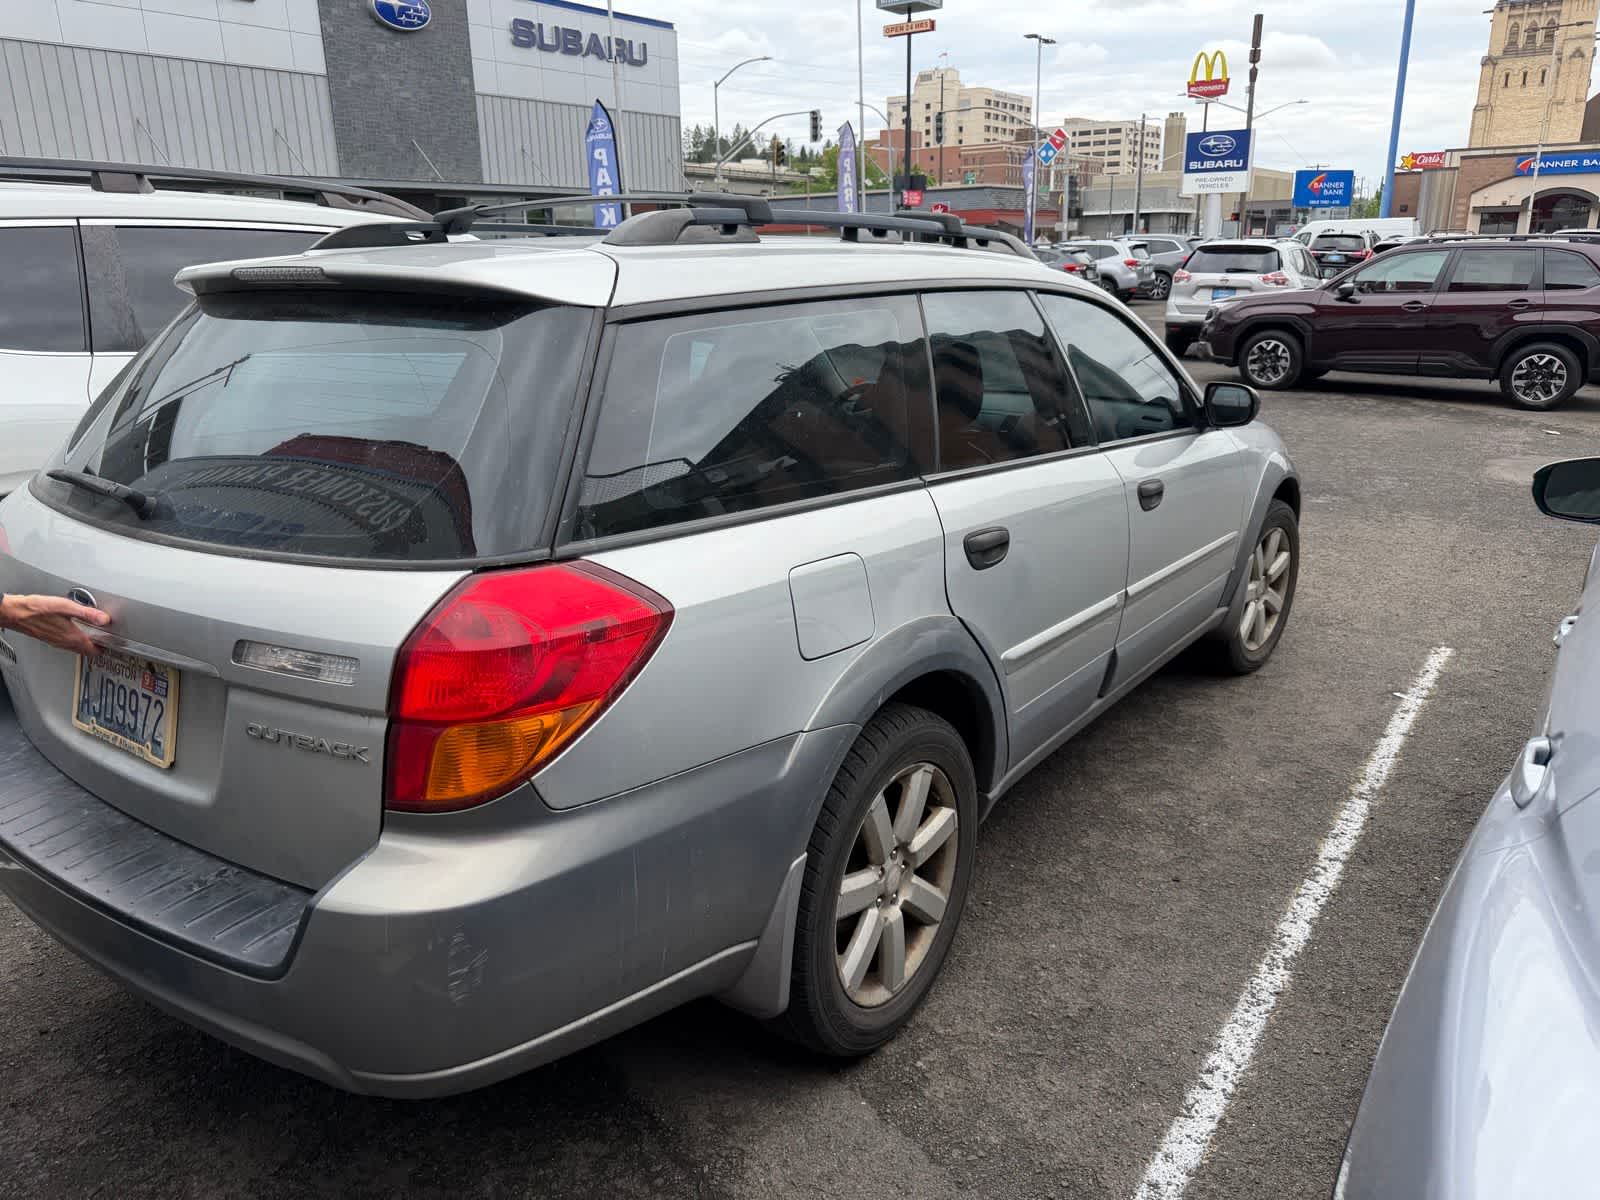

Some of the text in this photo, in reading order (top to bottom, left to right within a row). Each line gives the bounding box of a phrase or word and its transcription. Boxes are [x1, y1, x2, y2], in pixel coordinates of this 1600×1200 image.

[885, 24, 904, 34] OPEN
[511, 18, 647, 67] SUBARU
[1189, 159, 1244, 170] SUBARU
[1530, 159, 1600, 169] BANNER BA
[1313, 181, 1345, 189] BANNER
[80, 671, 165, 746] AJD9972
[246, 721, 369, 764] OUTBACK
